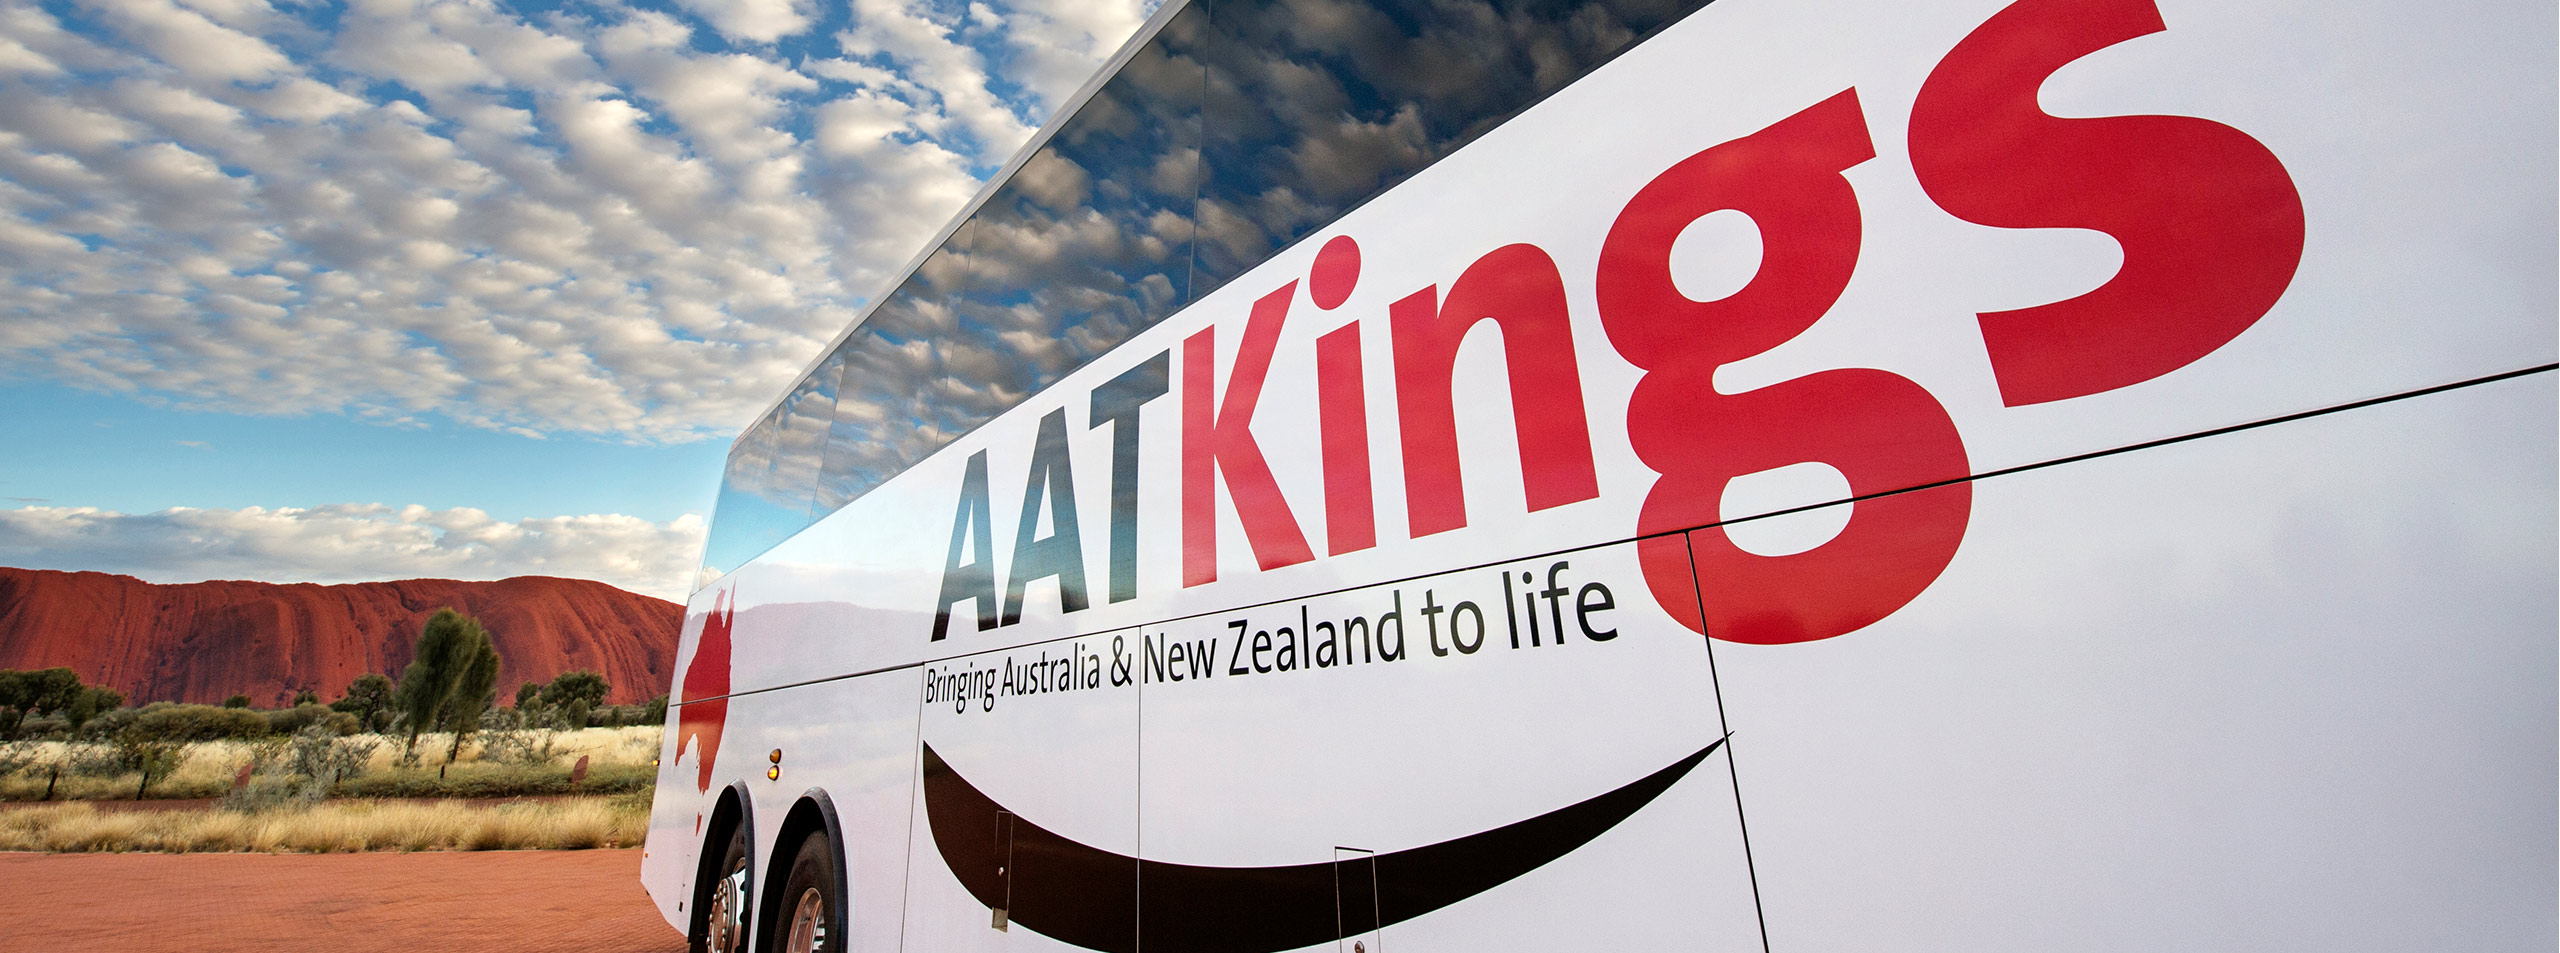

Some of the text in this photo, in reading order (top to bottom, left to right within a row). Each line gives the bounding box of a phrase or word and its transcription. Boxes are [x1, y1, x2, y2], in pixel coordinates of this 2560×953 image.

[925, 560, 1620, 714] Bringing Australia & New Zealand to life
